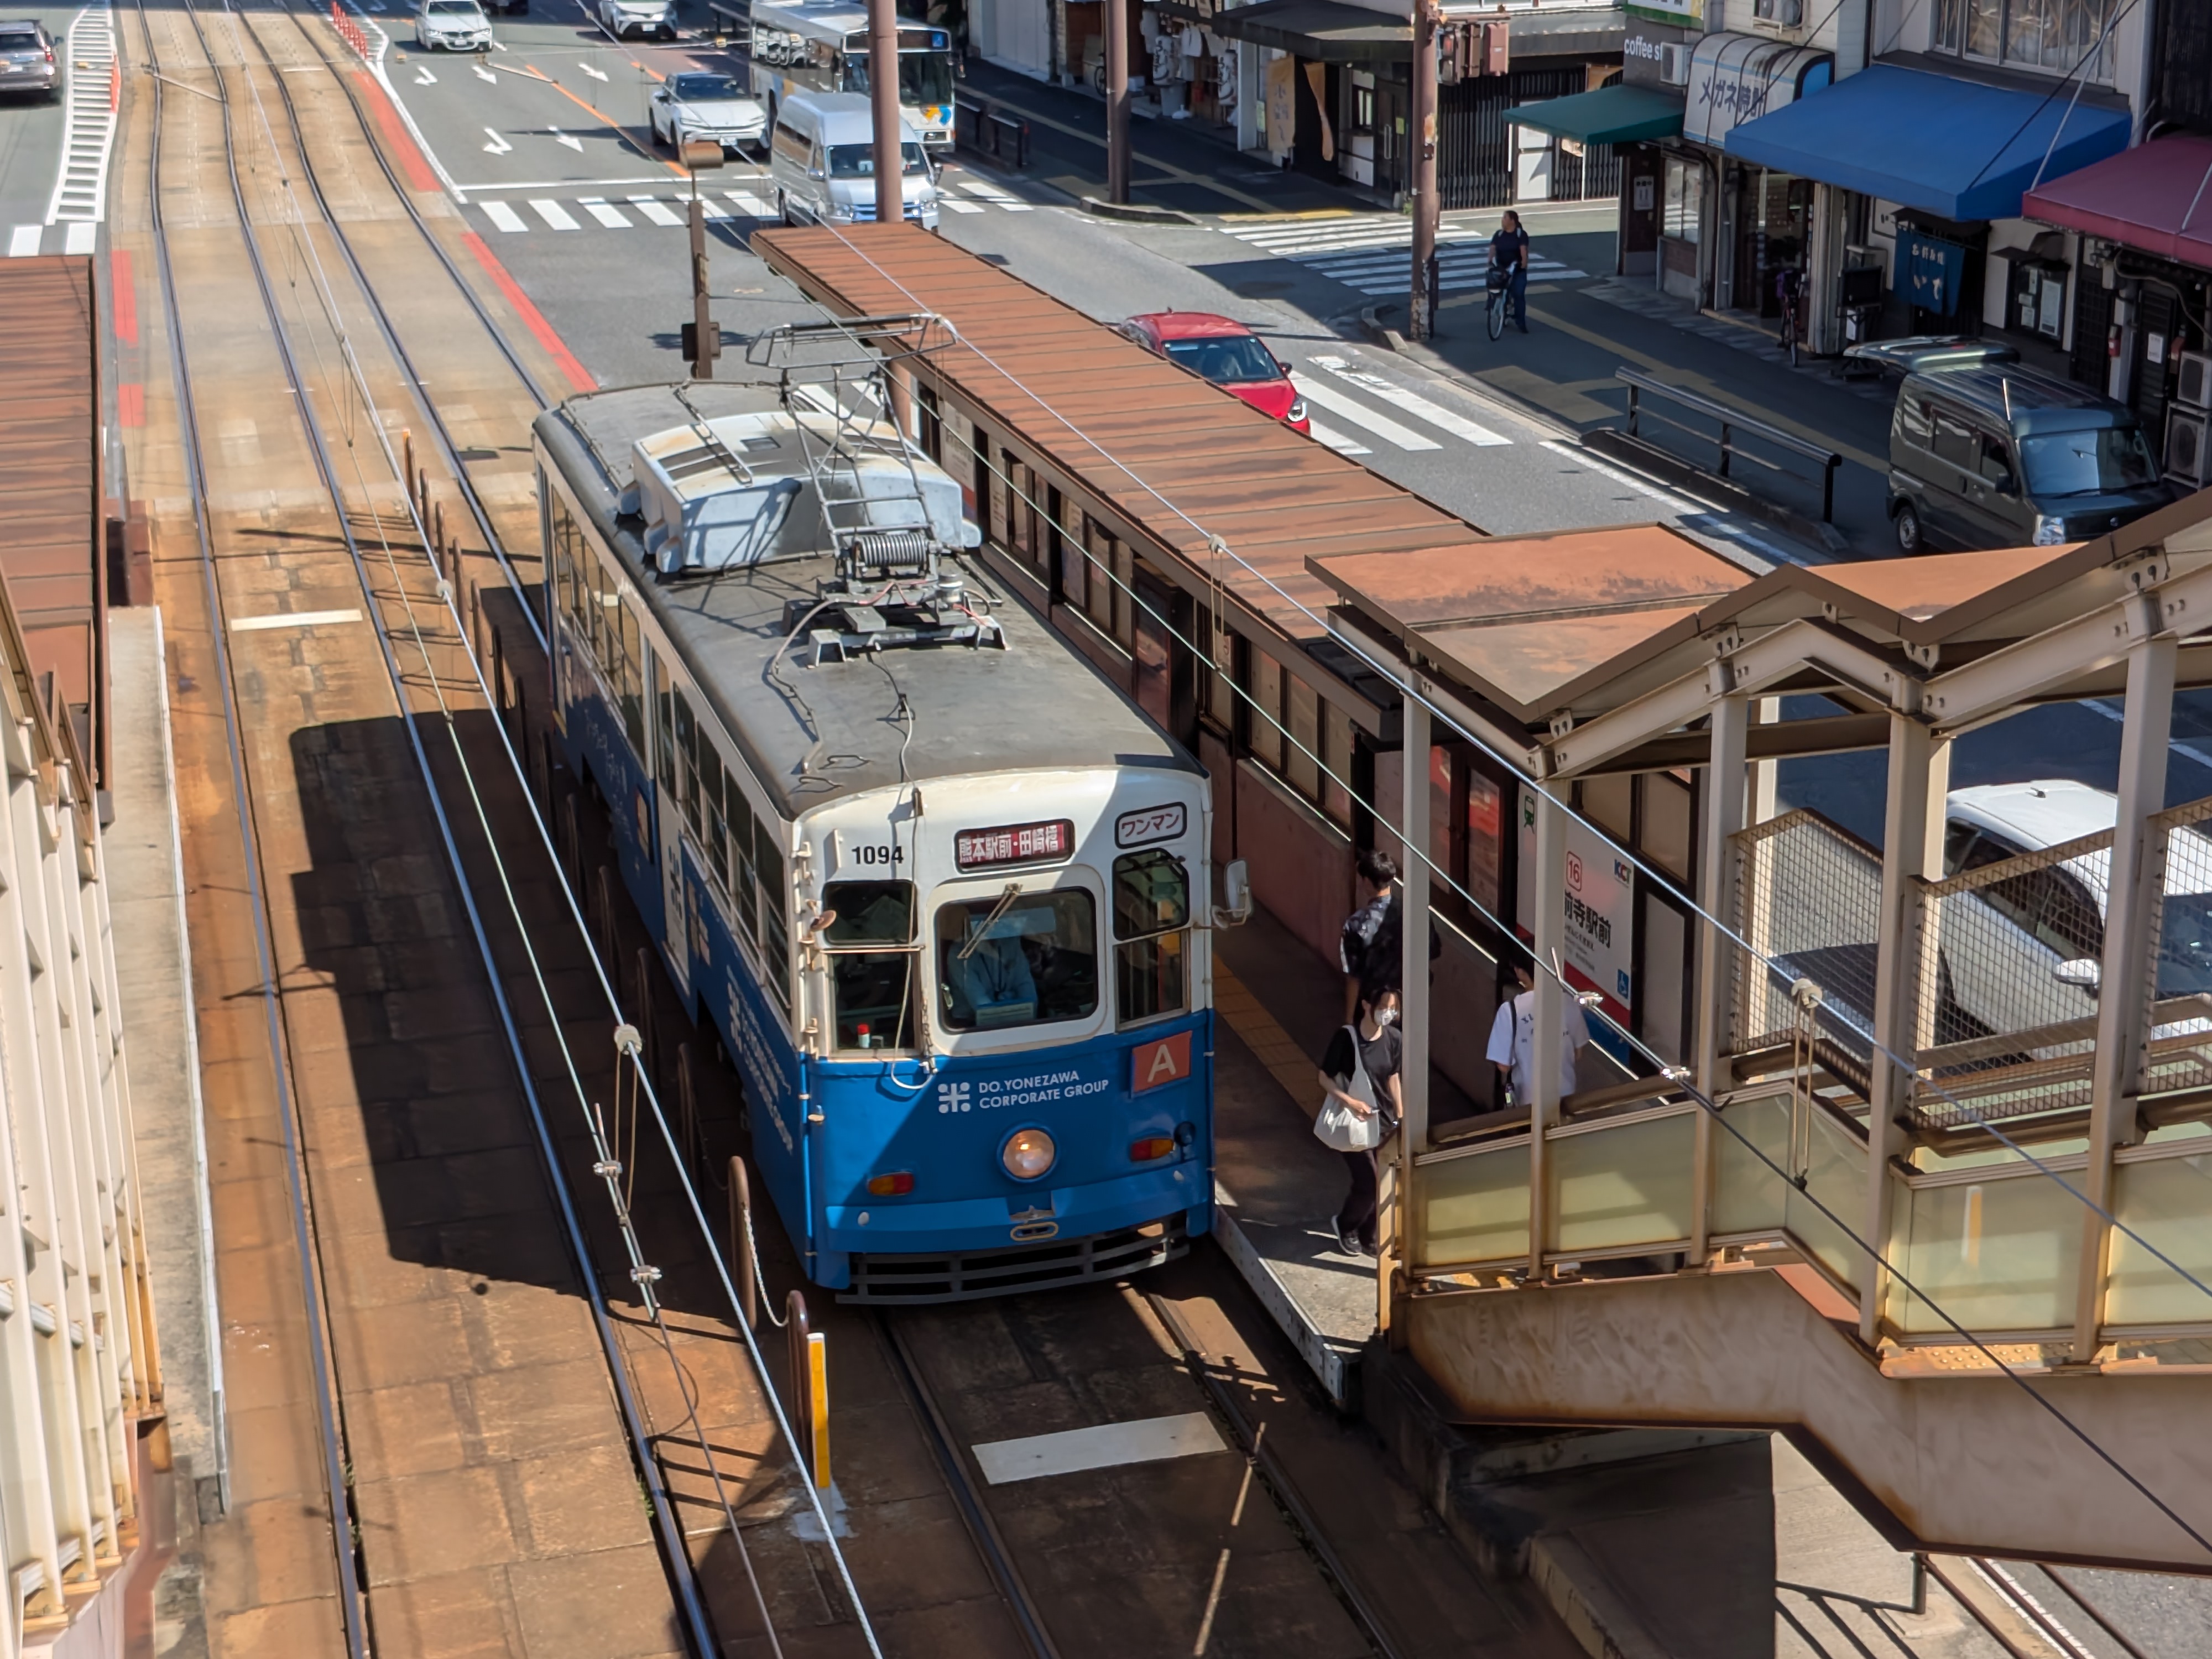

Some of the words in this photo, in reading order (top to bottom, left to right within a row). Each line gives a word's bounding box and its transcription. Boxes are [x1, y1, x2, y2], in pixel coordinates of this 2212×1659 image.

[1624, 35, 1652, 60] coffee
[1121, 813, 1180, 838] ワンマン
[852, 846, 904, 864] 1094
[1569, 860, 1580, 884] 16
[1147, 1044, 1176, 1083] A
[979, 1089, 1061, 1109] CORPORATE
[1064, 1079, 1109, 1096] GROUP
